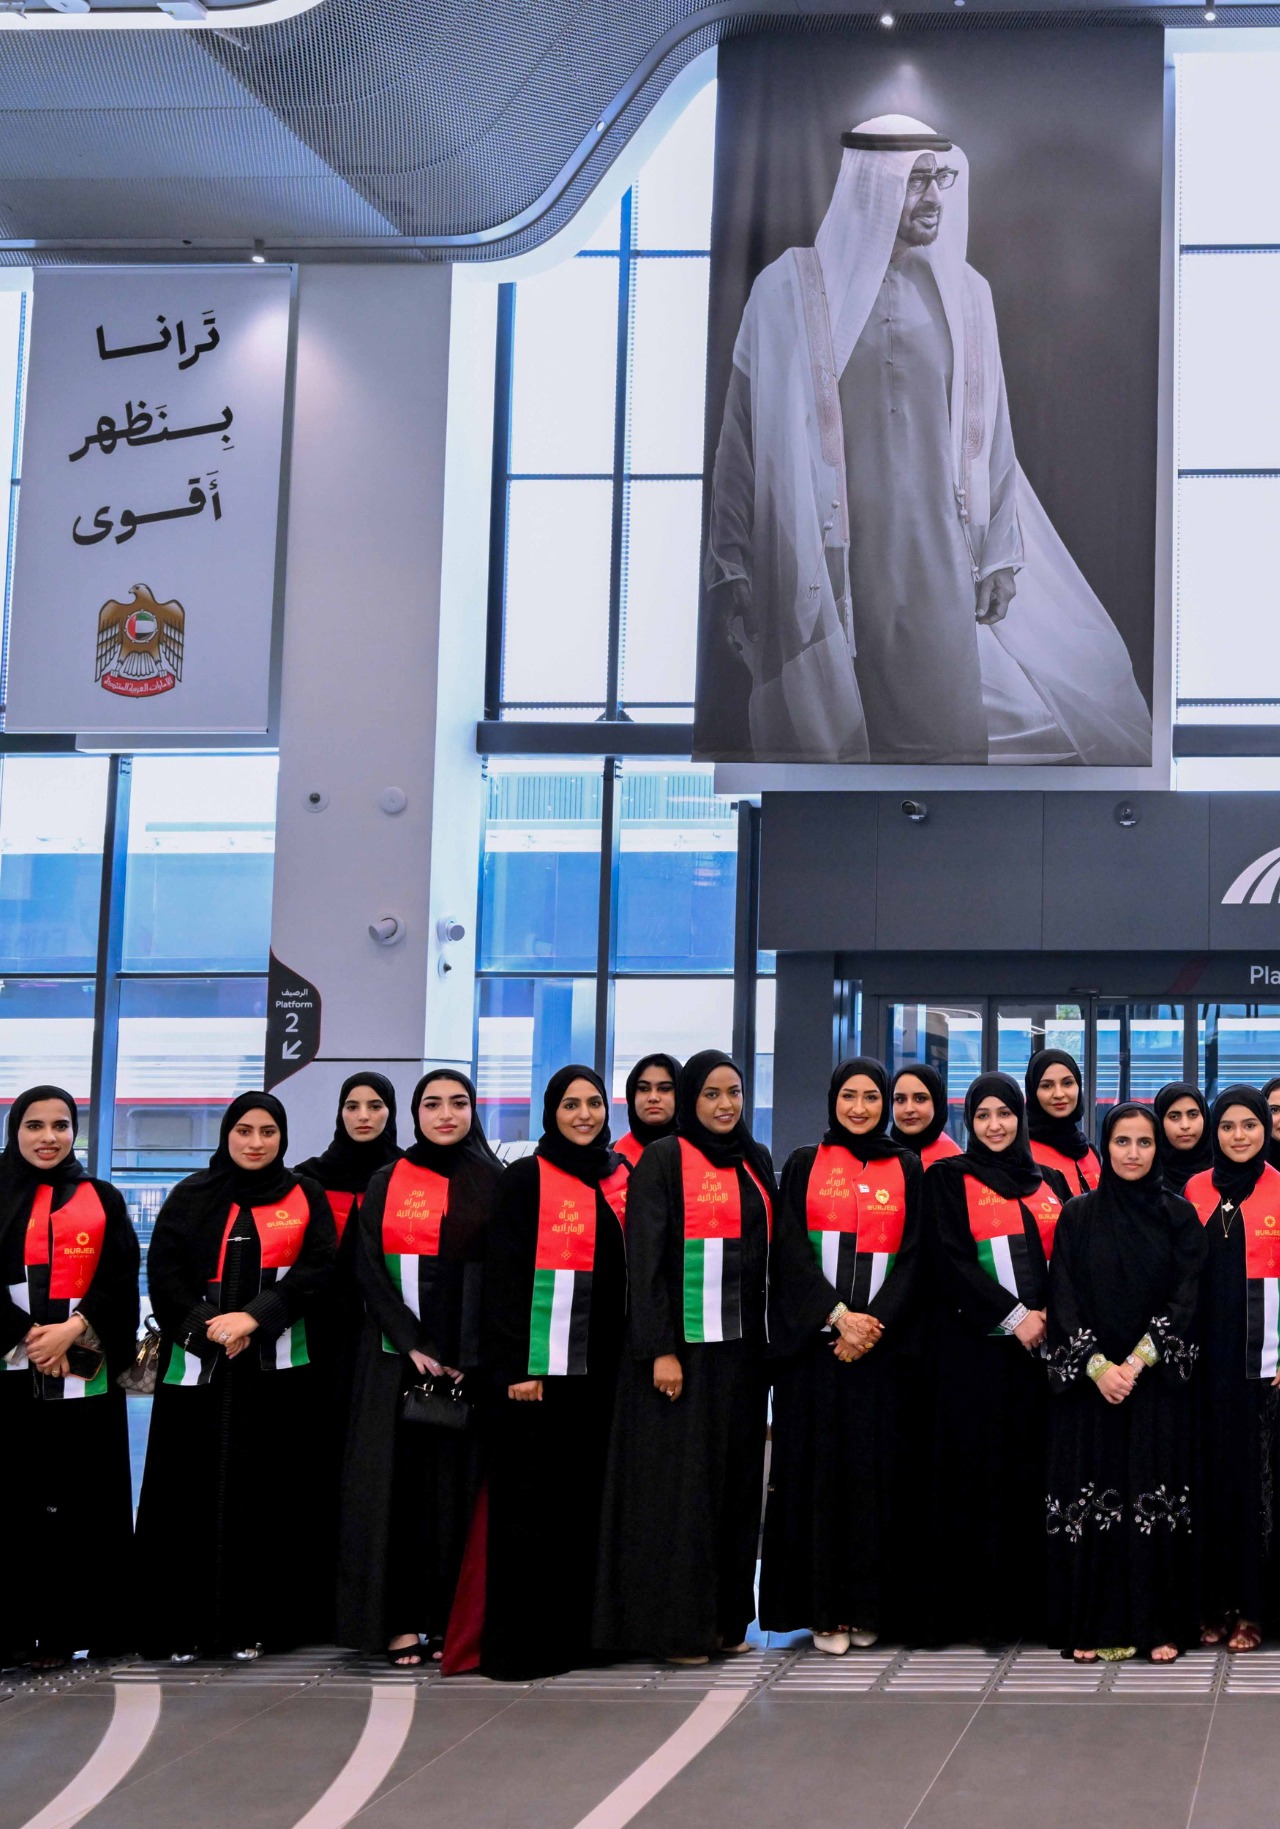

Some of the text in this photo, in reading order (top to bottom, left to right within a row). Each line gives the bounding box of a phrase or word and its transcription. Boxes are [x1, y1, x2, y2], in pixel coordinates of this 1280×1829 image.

[281, 988, 308, 998] الرصيف
[275, 1000, 312, 1008] Platform
[285, 1012, 299, 1033] 2
